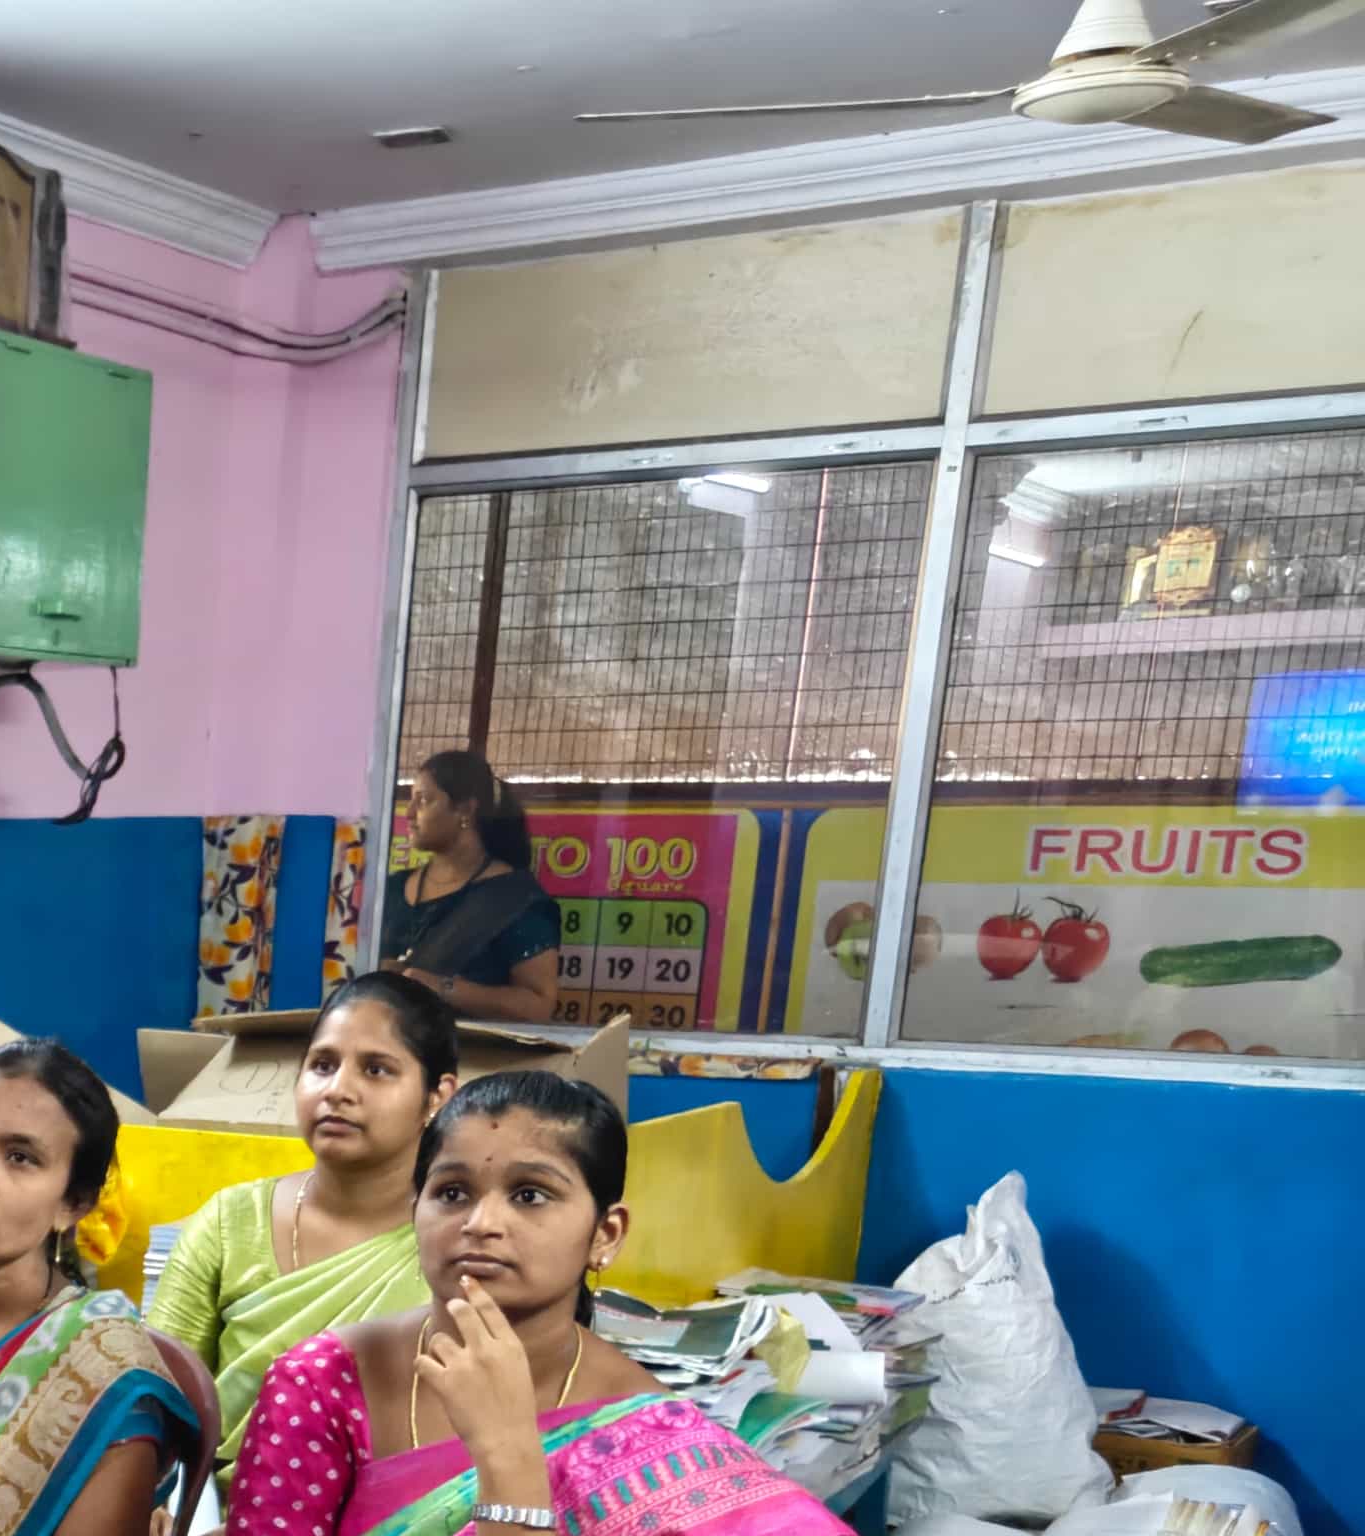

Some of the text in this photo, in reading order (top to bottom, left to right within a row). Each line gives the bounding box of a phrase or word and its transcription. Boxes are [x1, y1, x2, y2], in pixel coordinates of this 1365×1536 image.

[606, 837, 697, 879] 100
[1029, 829, 1303, 876] FRUITS
[564, 911, 693, 937] 8 9 10
[558, 955, 691, 982] 18 19 20
